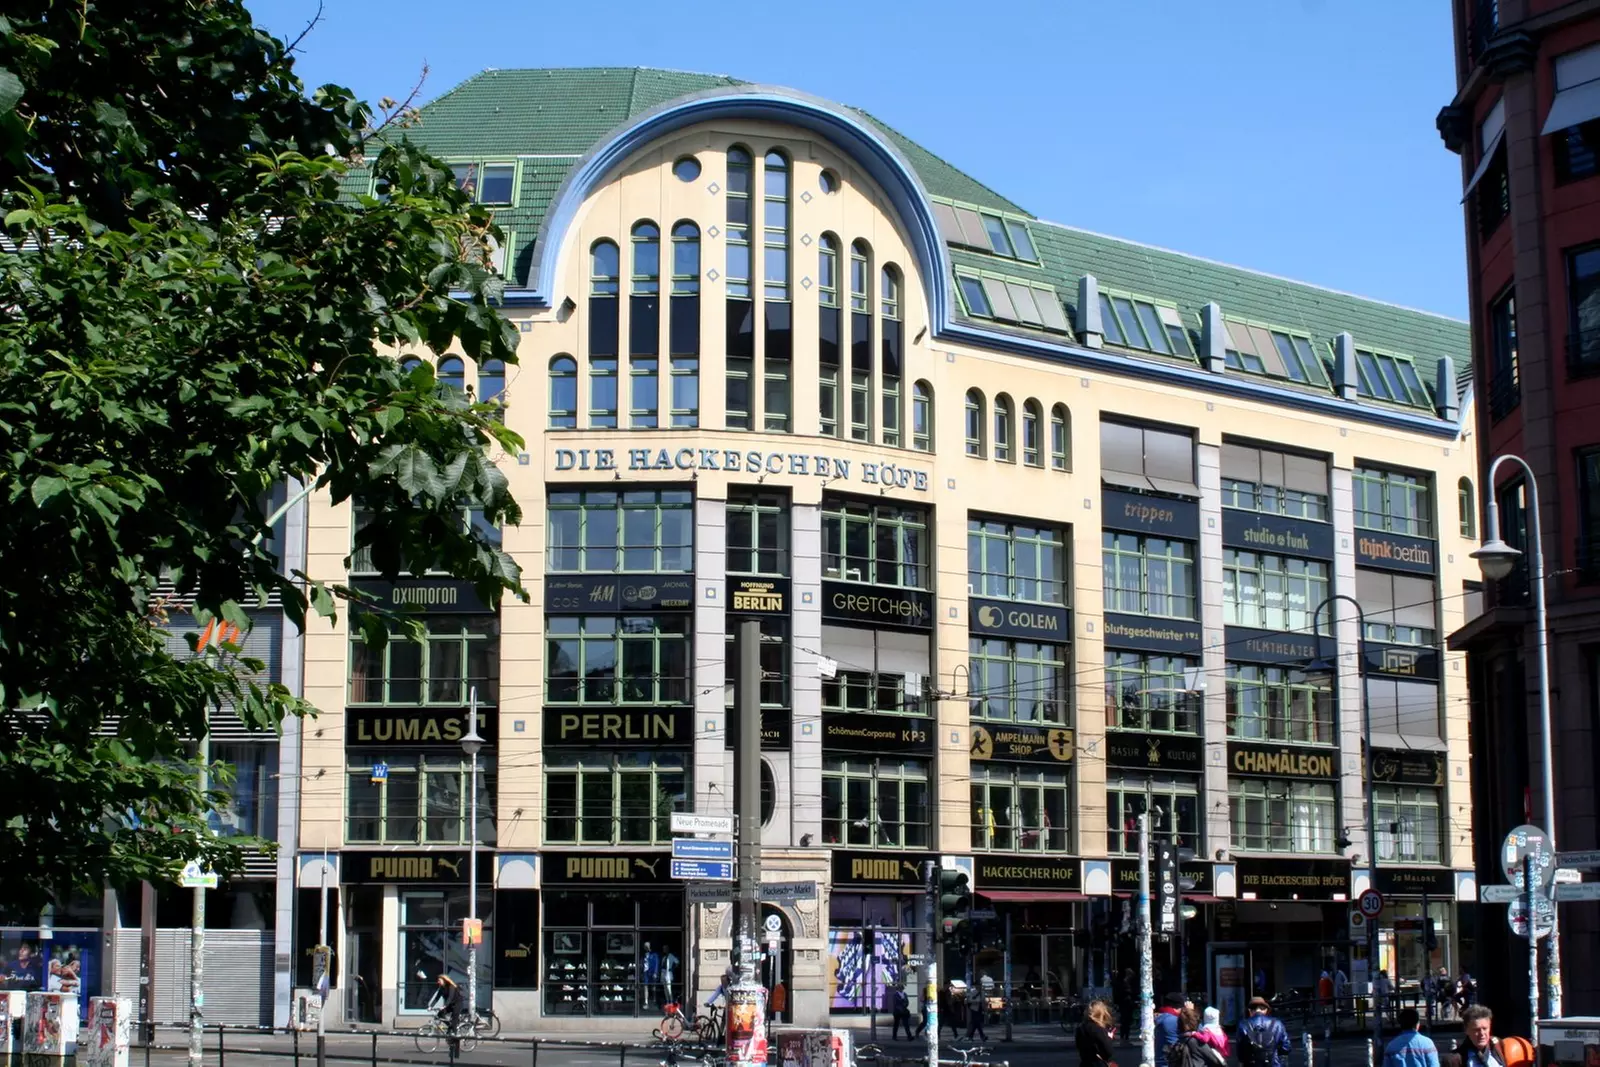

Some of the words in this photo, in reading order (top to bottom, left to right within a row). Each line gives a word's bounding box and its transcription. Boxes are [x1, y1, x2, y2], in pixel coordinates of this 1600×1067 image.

[555, 447, 615, 471] DIE
[629, 447, 851, 480] HACKESCHEN
[861, 460, 929, 492] HÖFE
[1124, 502, 1174, 523] trippen
[1243, 528, 1275, 544] studio
[1286, 534, 1309, 550] funk
[1392, 541, 1431, 565] berlin
[740, 581, 774, 590] HOFFNUNG
[551, 597, 580, 608] COS
[734, 596, 783, 612] BERLIN
[1008, 611, 1058, 631] GOLEM
[1104, 622, 1184, 642] blutsgeschwister
[1246, 640, 1316, 657] FILMTHEATER
[357, 718, 462, 741] LUMAS
[560, 714, 676, 739] PERLIN
[995, 732, 1045, 745] AMPELMANN
[1009, 744, 1032, 755] SHOP
[1110, 746, 1140, 757] RASUR
[1167, 750, 1197, 761] KULTUR
[1234, 749, 1332, 776] CHAMÄLEON
[676, 818, 693, 827] Neue
[694, 818, 729, 829] Promenade
[370, 857, 433, 879] PUMA
[566, 857, 630, 879] PUMA
[852, 858, 900, 880] PUMA
[982, 865, 1051, 880] HACKESCHER
[1052, 867, 1074, 881] HOF
[794, 884, 811, 894] Markt
[1243, 875, 1260, 885] DIE
[1261, 875, 1321, 886] HACKESCHEN
[1322, 874, 1346, 886] HÖFE
[1363, 896, 1379, 911] 30
